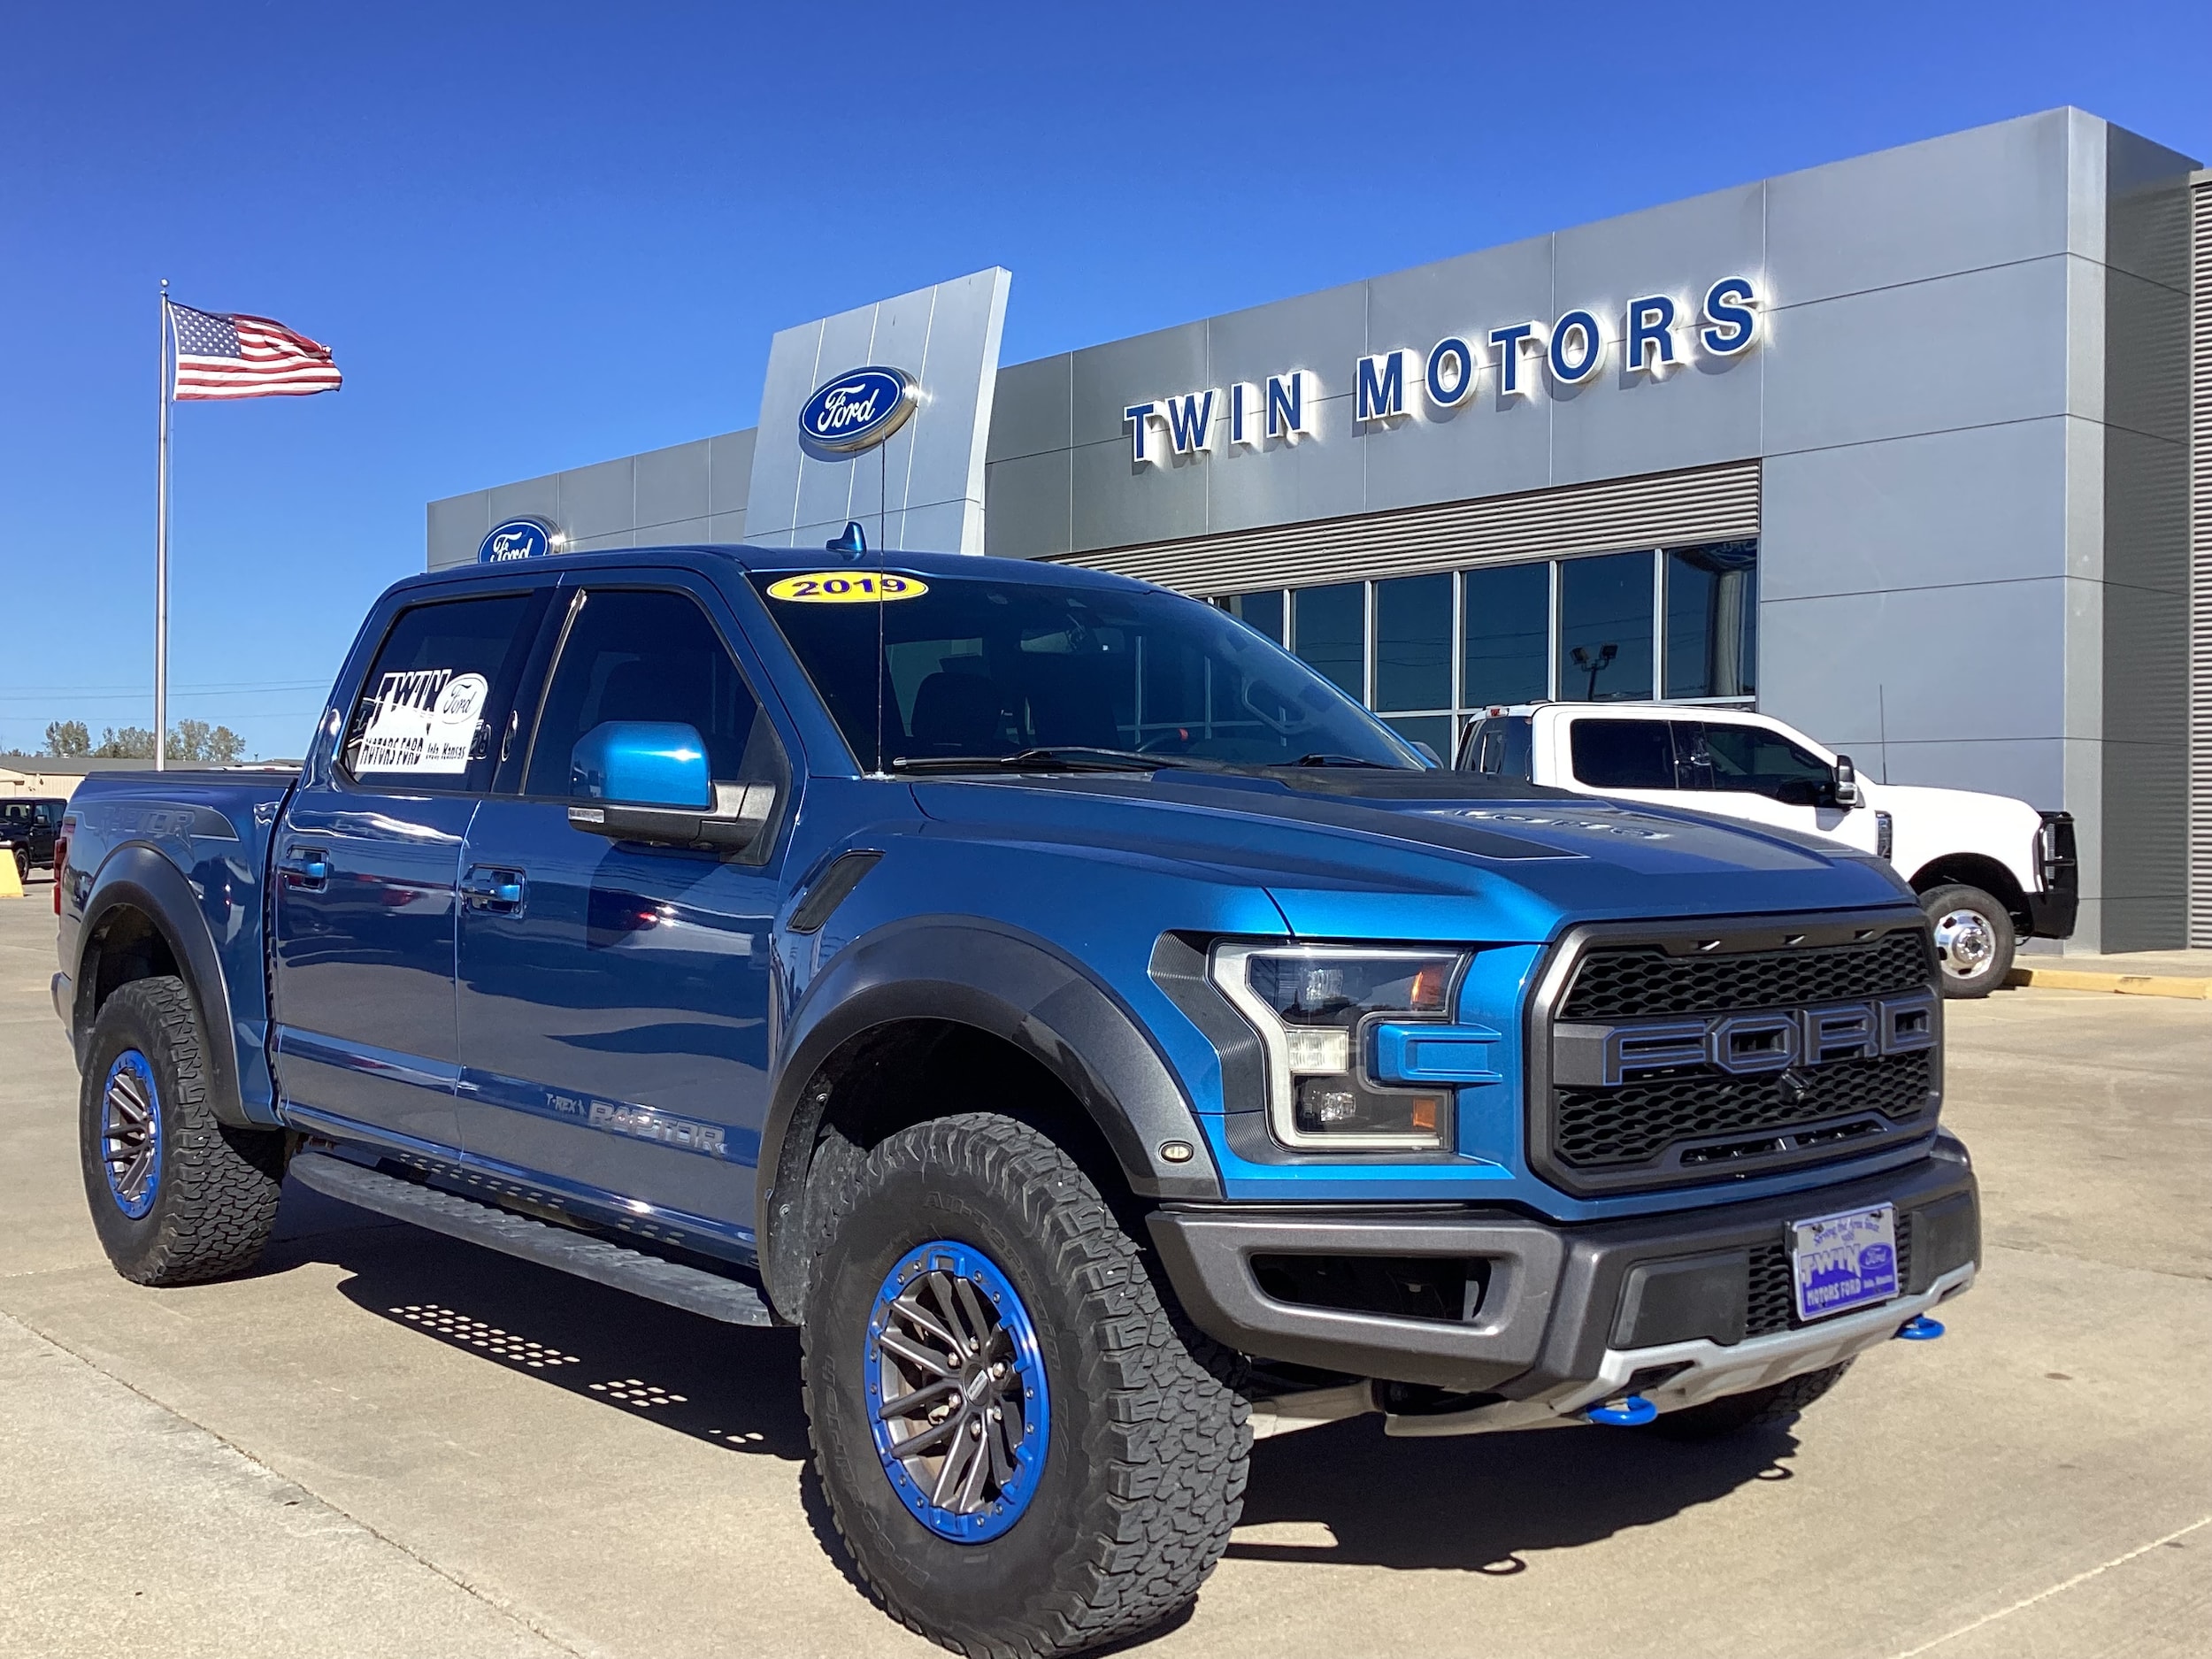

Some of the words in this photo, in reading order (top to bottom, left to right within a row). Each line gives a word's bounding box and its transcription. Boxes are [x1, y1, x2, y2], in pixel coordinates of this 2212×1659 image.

[1124, 369, 1310, 462] TWIN
[1356, 276, 1761, 422] MOTORS
[817, 383, 879, 433] Ford
[489, 531, 534, 563] Ford
[792, 578, 908, 597] 2019
[370, 670, 452, 733] TWIN
[442, 683, 478, 714] Ford
[1602, 993, 1939, 1087] FORD
[588, 1100, 728, 1157] RAPTOR
[1800, 1243, 1862, 1287] TWIN
[1864, 1247, 1886, 1266] Ford
[1806, 1282, 1840, 1307] MOTORS
[1839, 1278, 1862, 1298] FORD
